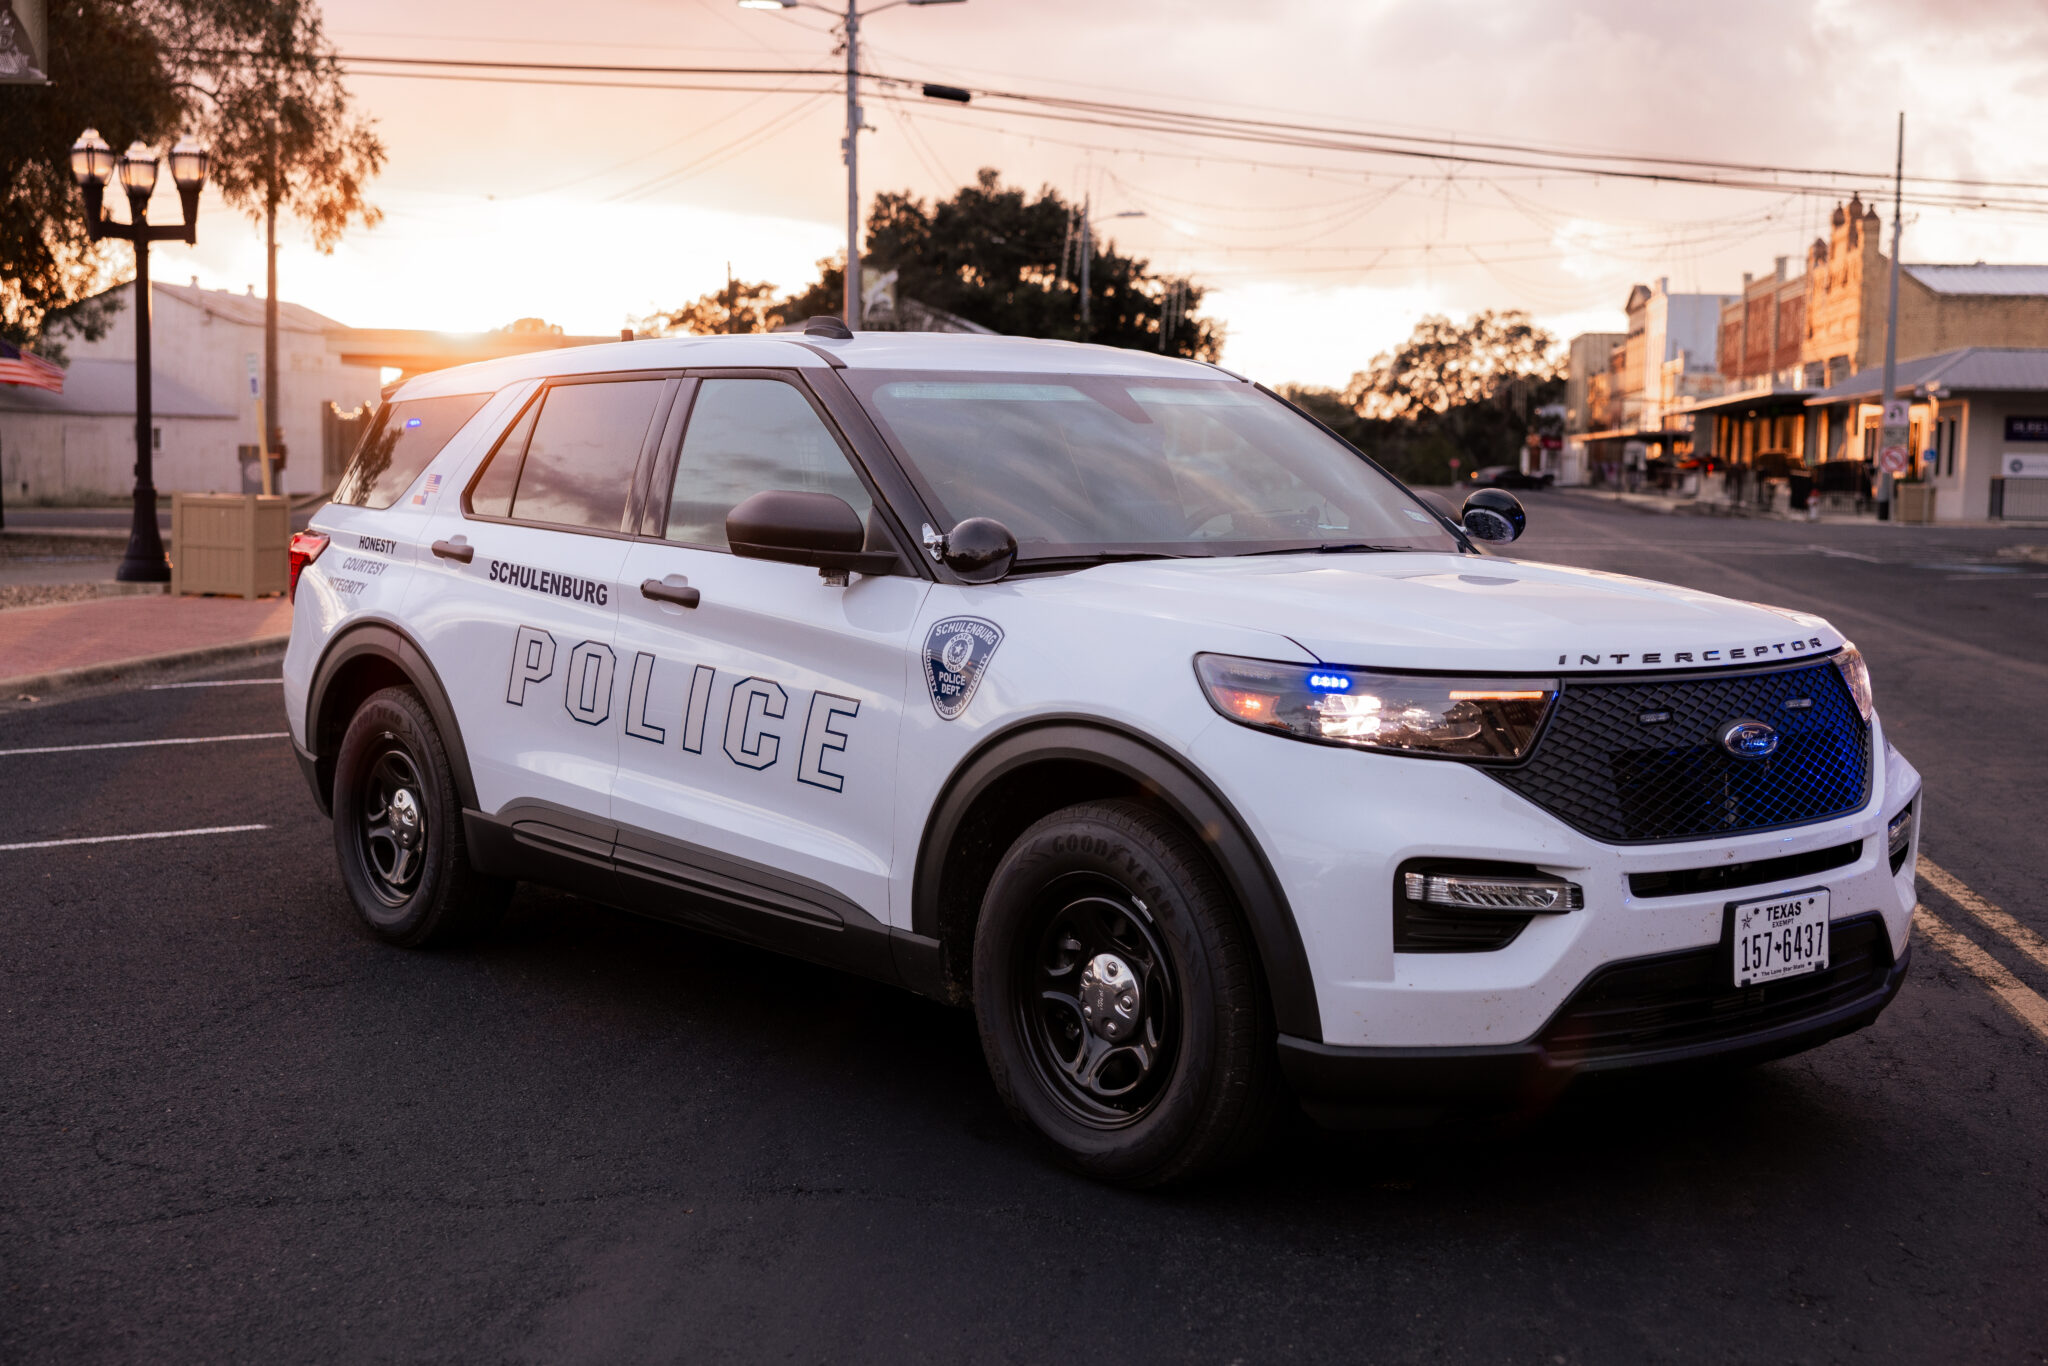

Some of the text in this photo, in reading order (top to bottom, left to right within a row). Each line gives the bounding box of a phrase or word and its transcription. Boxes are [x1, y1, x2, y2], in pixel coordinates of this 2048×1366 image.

[359, 536, 397, 554] HONESTY
[343, 557, 389, 576] COURTESY
[328, 576, 368, 596] INTEGRITY
[489, 560, 608, 606] SCHULENBURG
[935, 621, 998, 645] SCHULENBURG
[1558, 637, 1823, 665] INTERCEPTOR
[926, 648, 988, 715] HONESTY COURTESY INTEGRITY
[938, 671, 966, 686] POLICE
[941, 683, 961, 697] DEPT.
[506, 624, 862, 793] POLICE
[1740, 729, 1769, 750] Ford
[1766, 901, 1802, 921] TEXAS
[1772, 918, 1795, 928] EXEMPT
